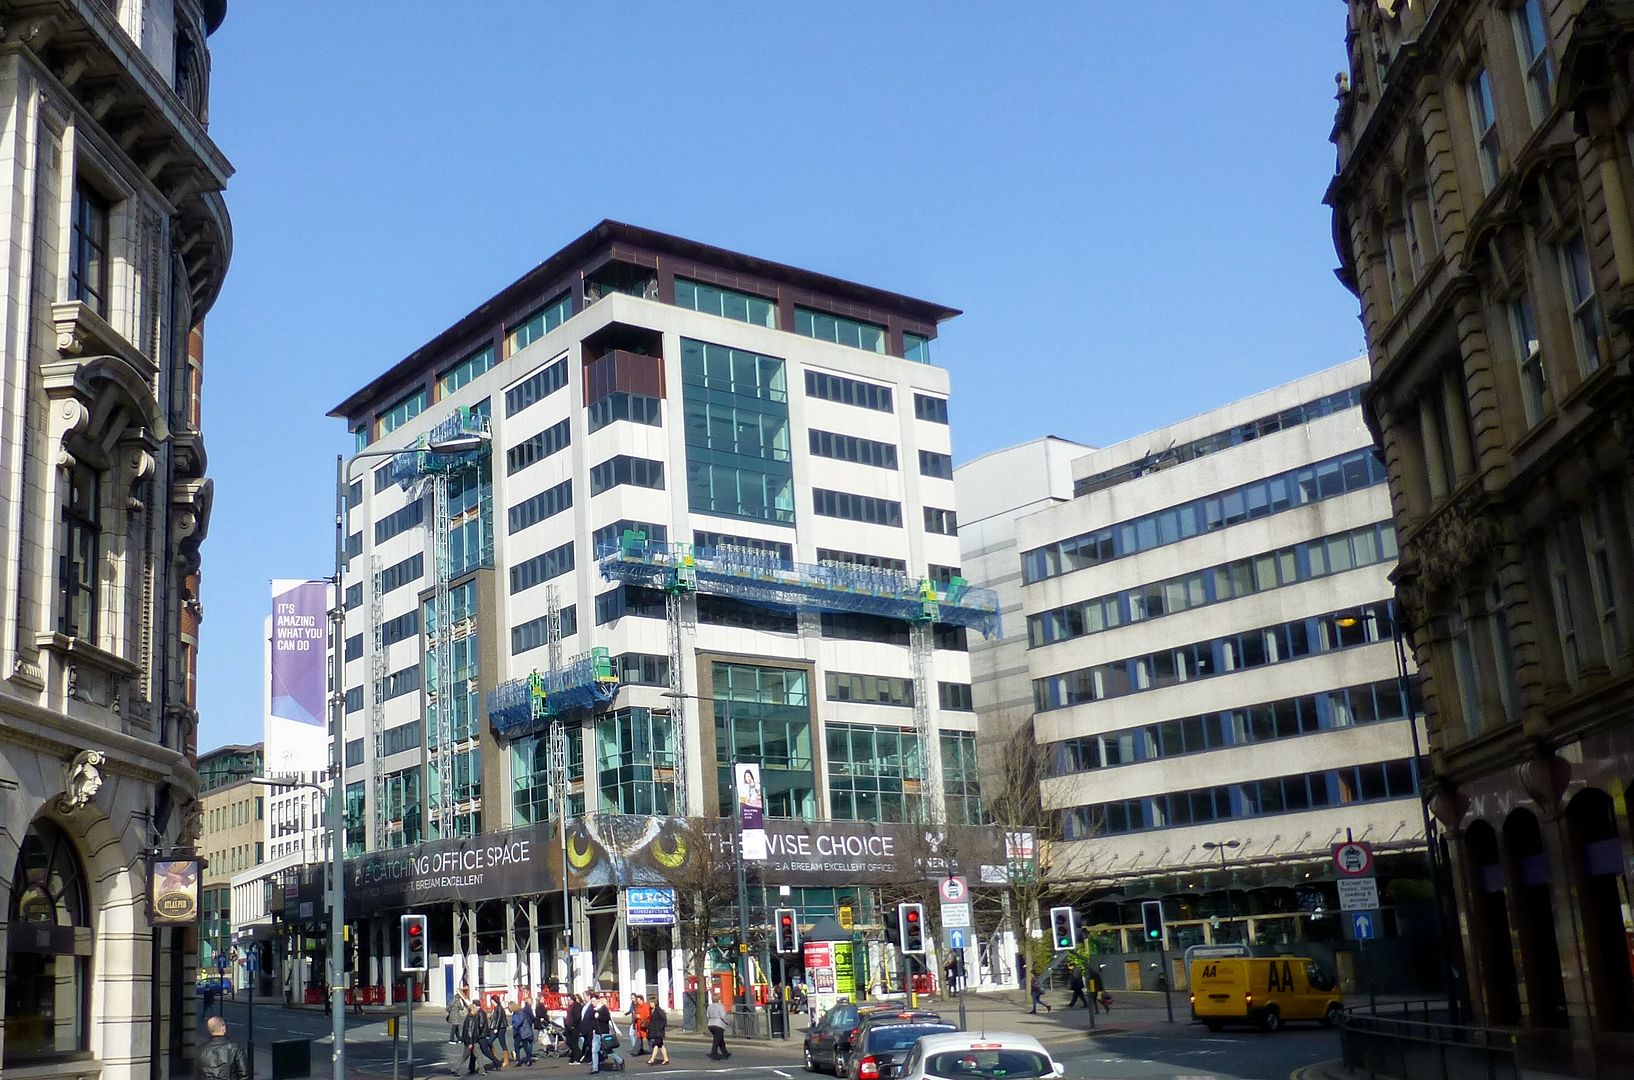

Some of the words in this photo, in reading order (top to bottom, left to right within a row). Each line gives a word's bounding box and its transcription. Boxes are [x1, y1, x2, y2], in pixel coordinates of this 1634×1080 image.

[277, 603, 296, 614] IT'S
[277, 615, 316, 627] AMAZING
[277, 627, 304, 639] WHAT
[305, 627, 323, 639] YOU
[277, 639, 296, 651] CAN
[297, 639, 310, 651] DO
[816, 835, 895, 857] CHOICE
[431, 849, 484, 874] OFFICE
[486, 841, 530, 867] SPACE
[791, 862, 823, 872] BREEAM
[824, 862, 867, 872] EXCELLENT
[441, 873, 484, 888] EXCELLENT
[1202, 965, 1217, 978] AA
[1267, 960, 1295, 993] AA
